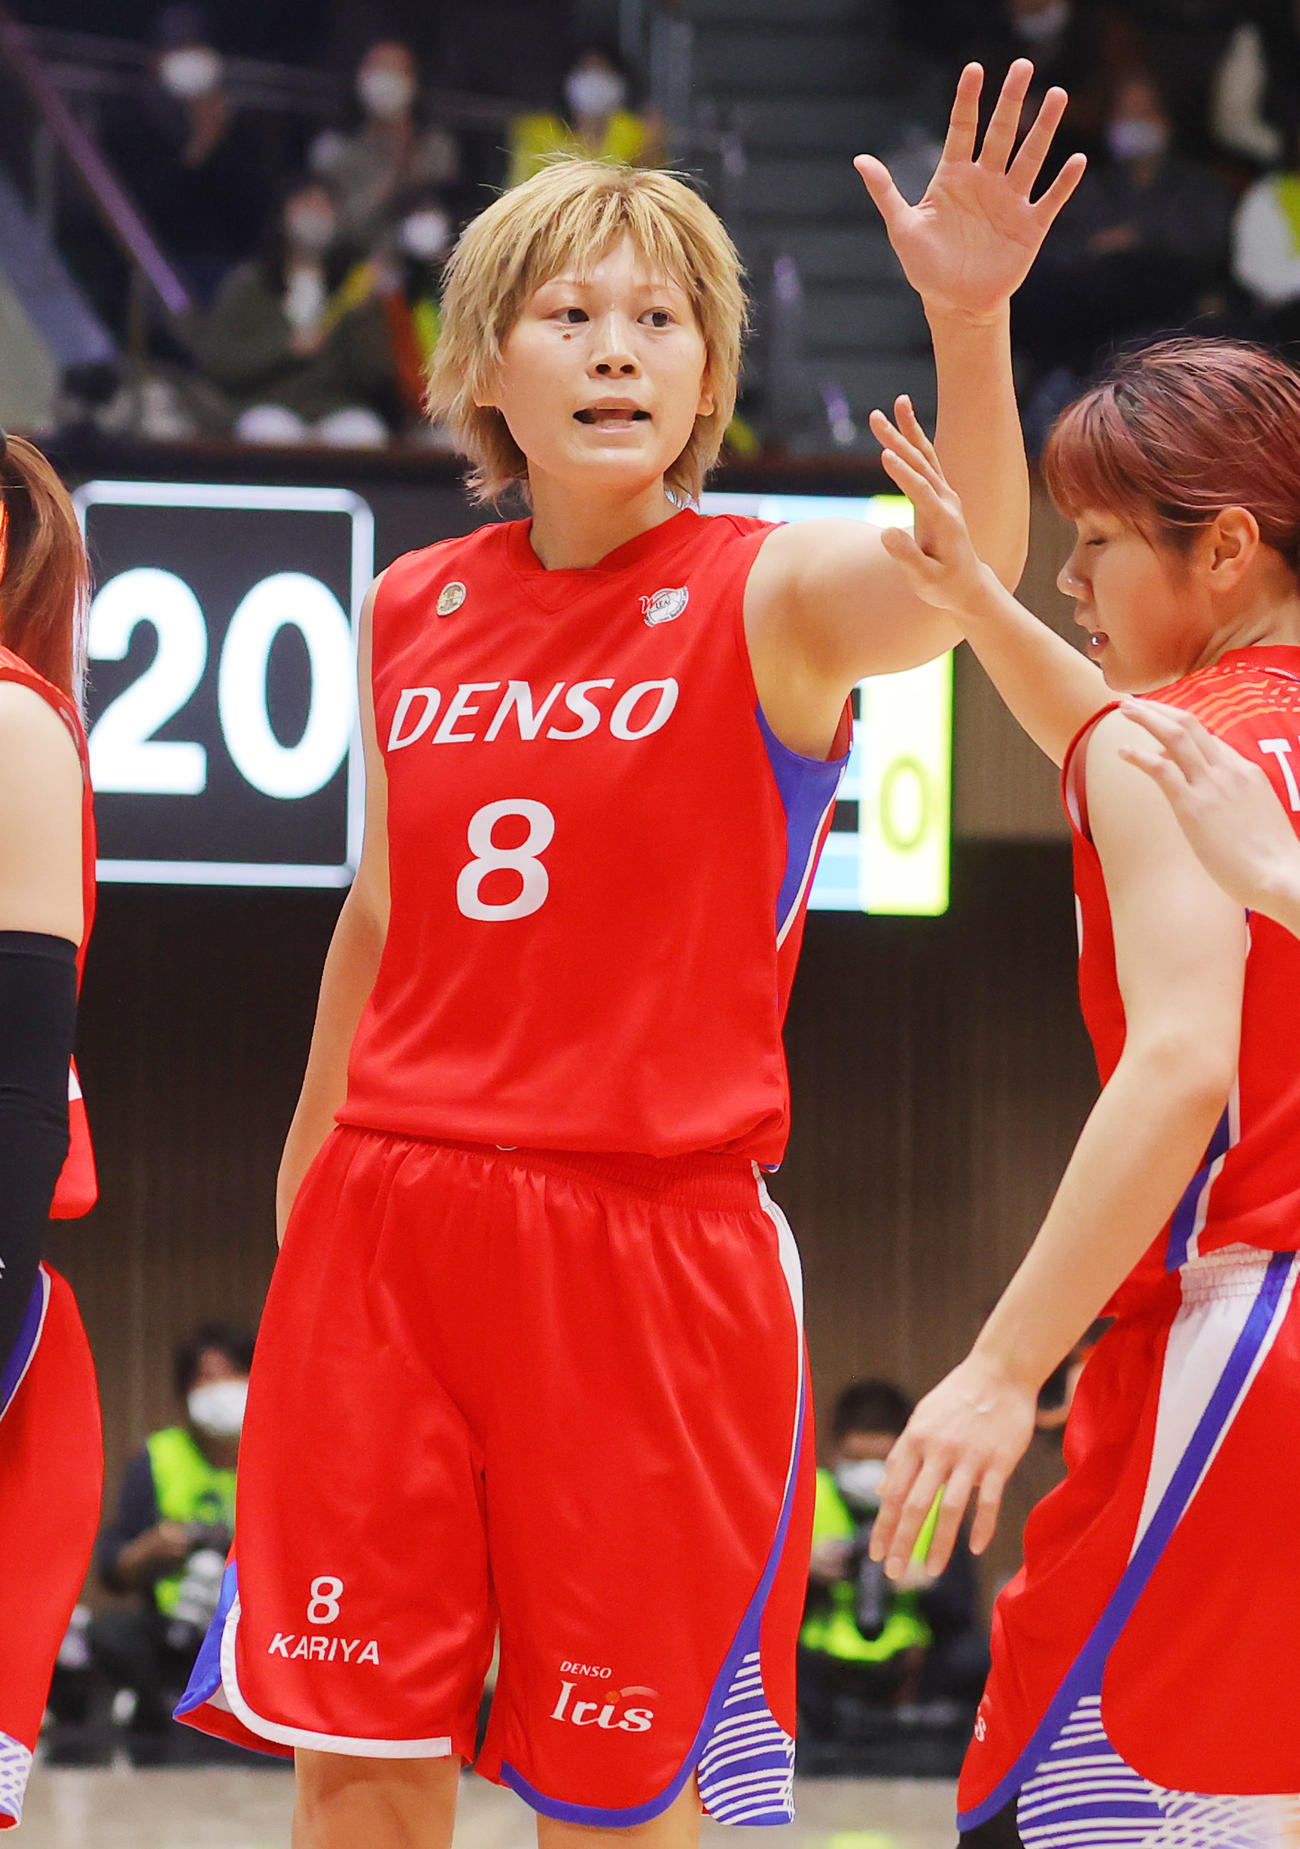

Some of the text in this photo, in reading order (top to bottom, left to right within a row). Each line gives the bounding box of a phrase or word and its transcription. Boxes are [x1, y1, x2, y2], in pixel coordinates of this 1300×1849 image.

[88, 567, 352, 800] 20
[387, 677, 679, 752] DENSO
[1258, 737, 1300, 812] T
[456, 798, 555, 922] 8
[307, 1575, 344, 1625] 8
[267, 1632, 380, 1666] KARIYA
[560, 1660, 612, 1679] DENSO
[549, 1680, 654, 1732] Iris
